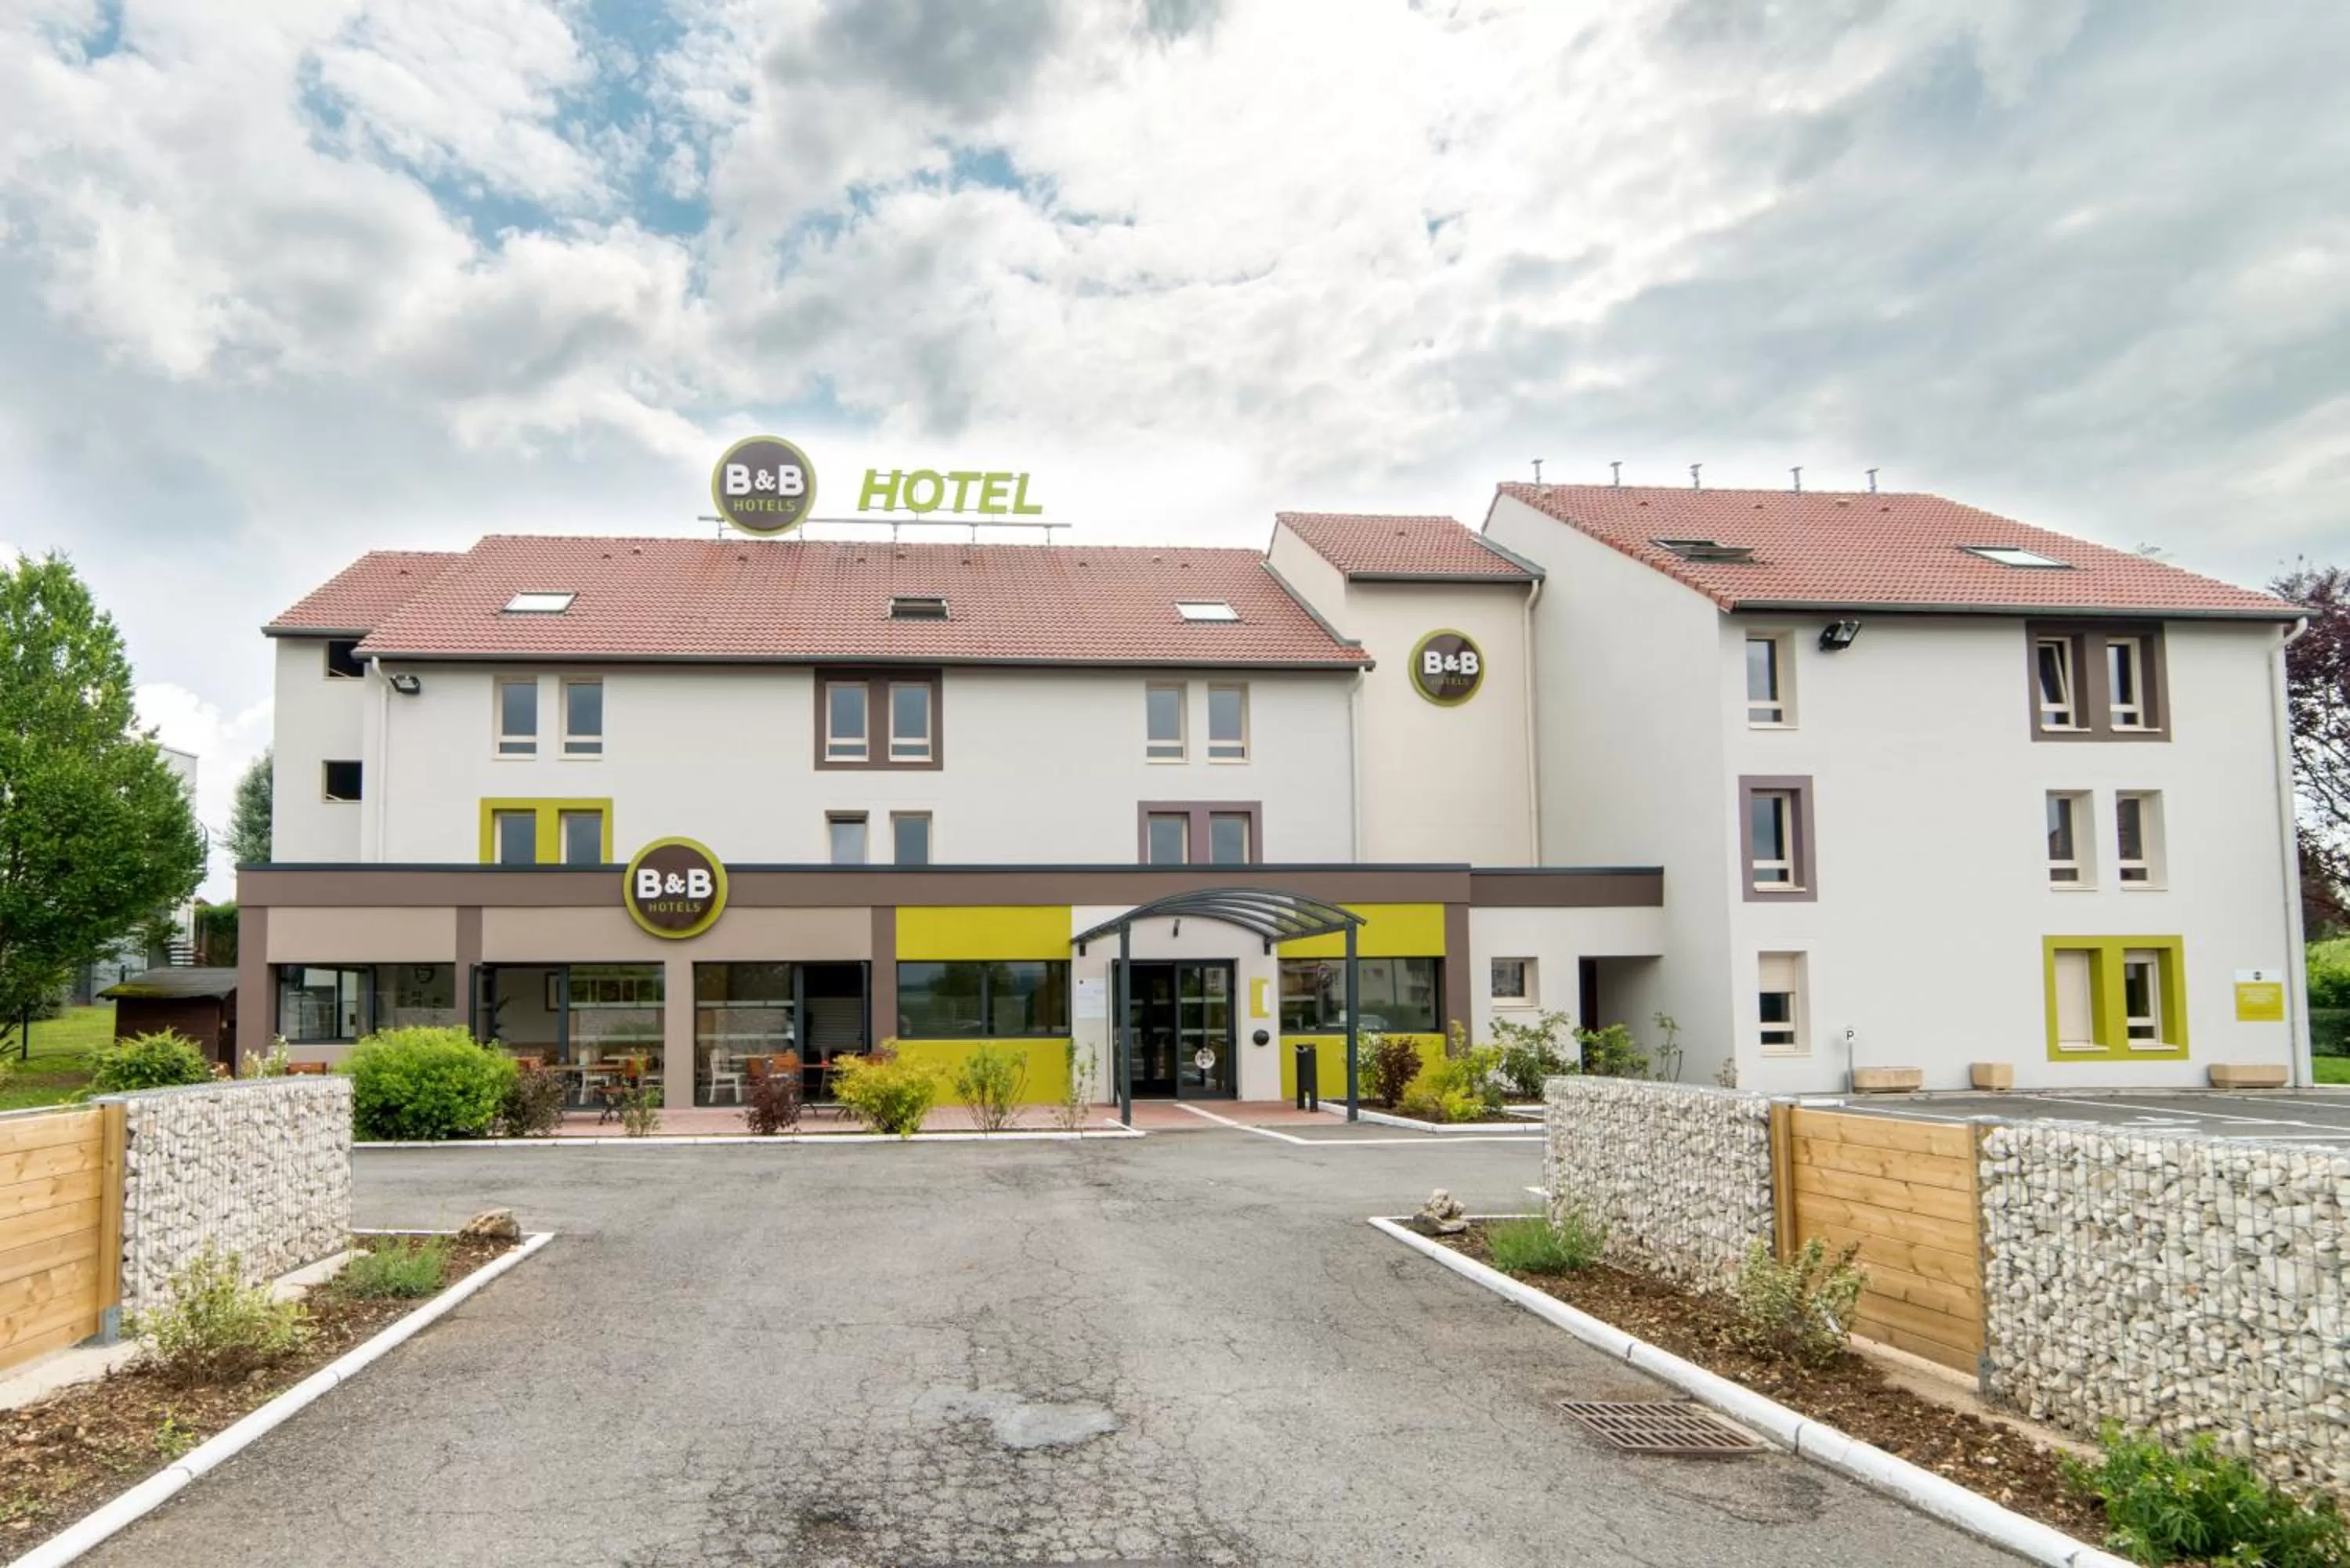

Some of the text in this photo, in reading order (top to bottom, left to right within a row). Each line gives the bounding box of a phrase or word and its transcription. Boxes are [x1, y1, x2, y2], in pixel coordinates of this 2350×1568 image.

[726, 463, 804, 496] B&B
[857, 468, 1043, 515] HOTEL
[733, 499, 797, 511] HOTELS
[1423, 651, 1480, 674] B&B
[637, 869, 713, 898] B&B
[648, 901, 702, 912] HOTELS
[1846, 1030, 1854, 1040] P
